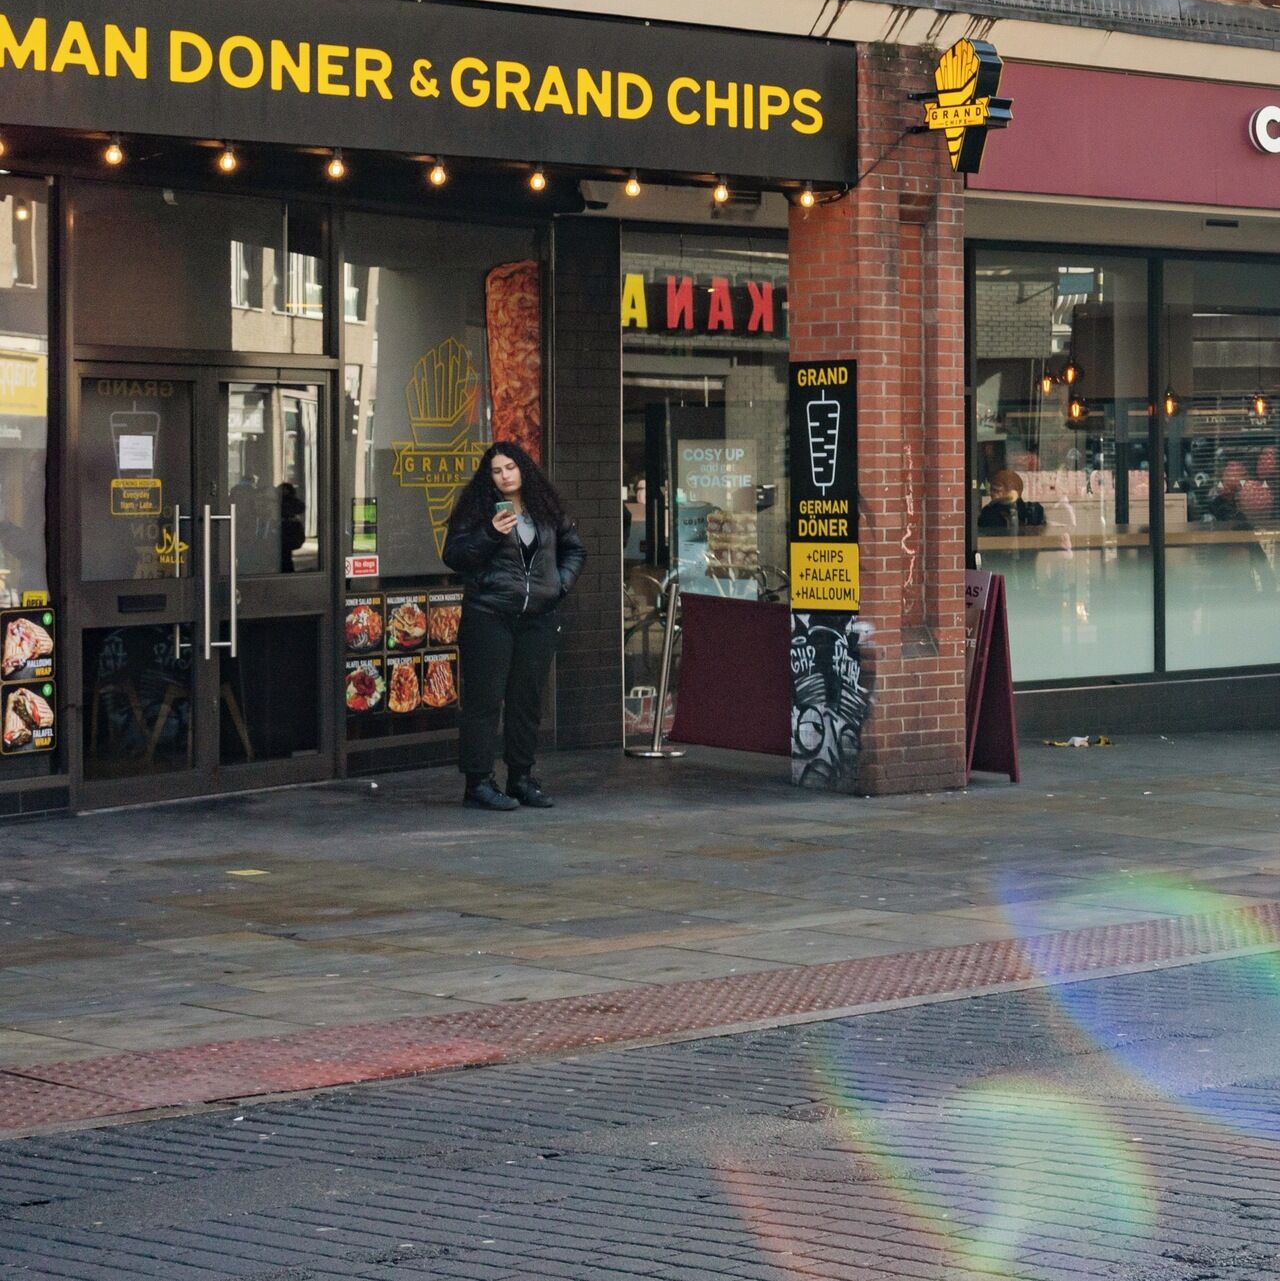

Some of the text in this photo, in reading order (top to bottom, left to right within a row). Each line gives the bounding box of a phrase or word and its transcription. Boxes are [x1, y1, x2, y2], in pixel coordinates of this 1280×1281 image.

[0, 14, 824, 135] MAN DONER & GRAND CHIPS
[931, 107, 981, 121] GRAND
[797, 366, 849, 386] GRAND
[683, 448, 745, 461] COSY UP
[404, 457, 480, 472] GRAND
[426, 474, 460, 483] CHIPS
[694, 474, 752, 487] TOASTIE
[799, 499, 849, 514] GERMAN
[798, 515, 849, 537] DÖNER
[806, 549, 844, 563] +CHIPS
[799, 568, 852, 584] +FALAFEL
[795, 586, 856, 603] +HALLOUMI
[33, 728, 53, 737] FALAFEL
